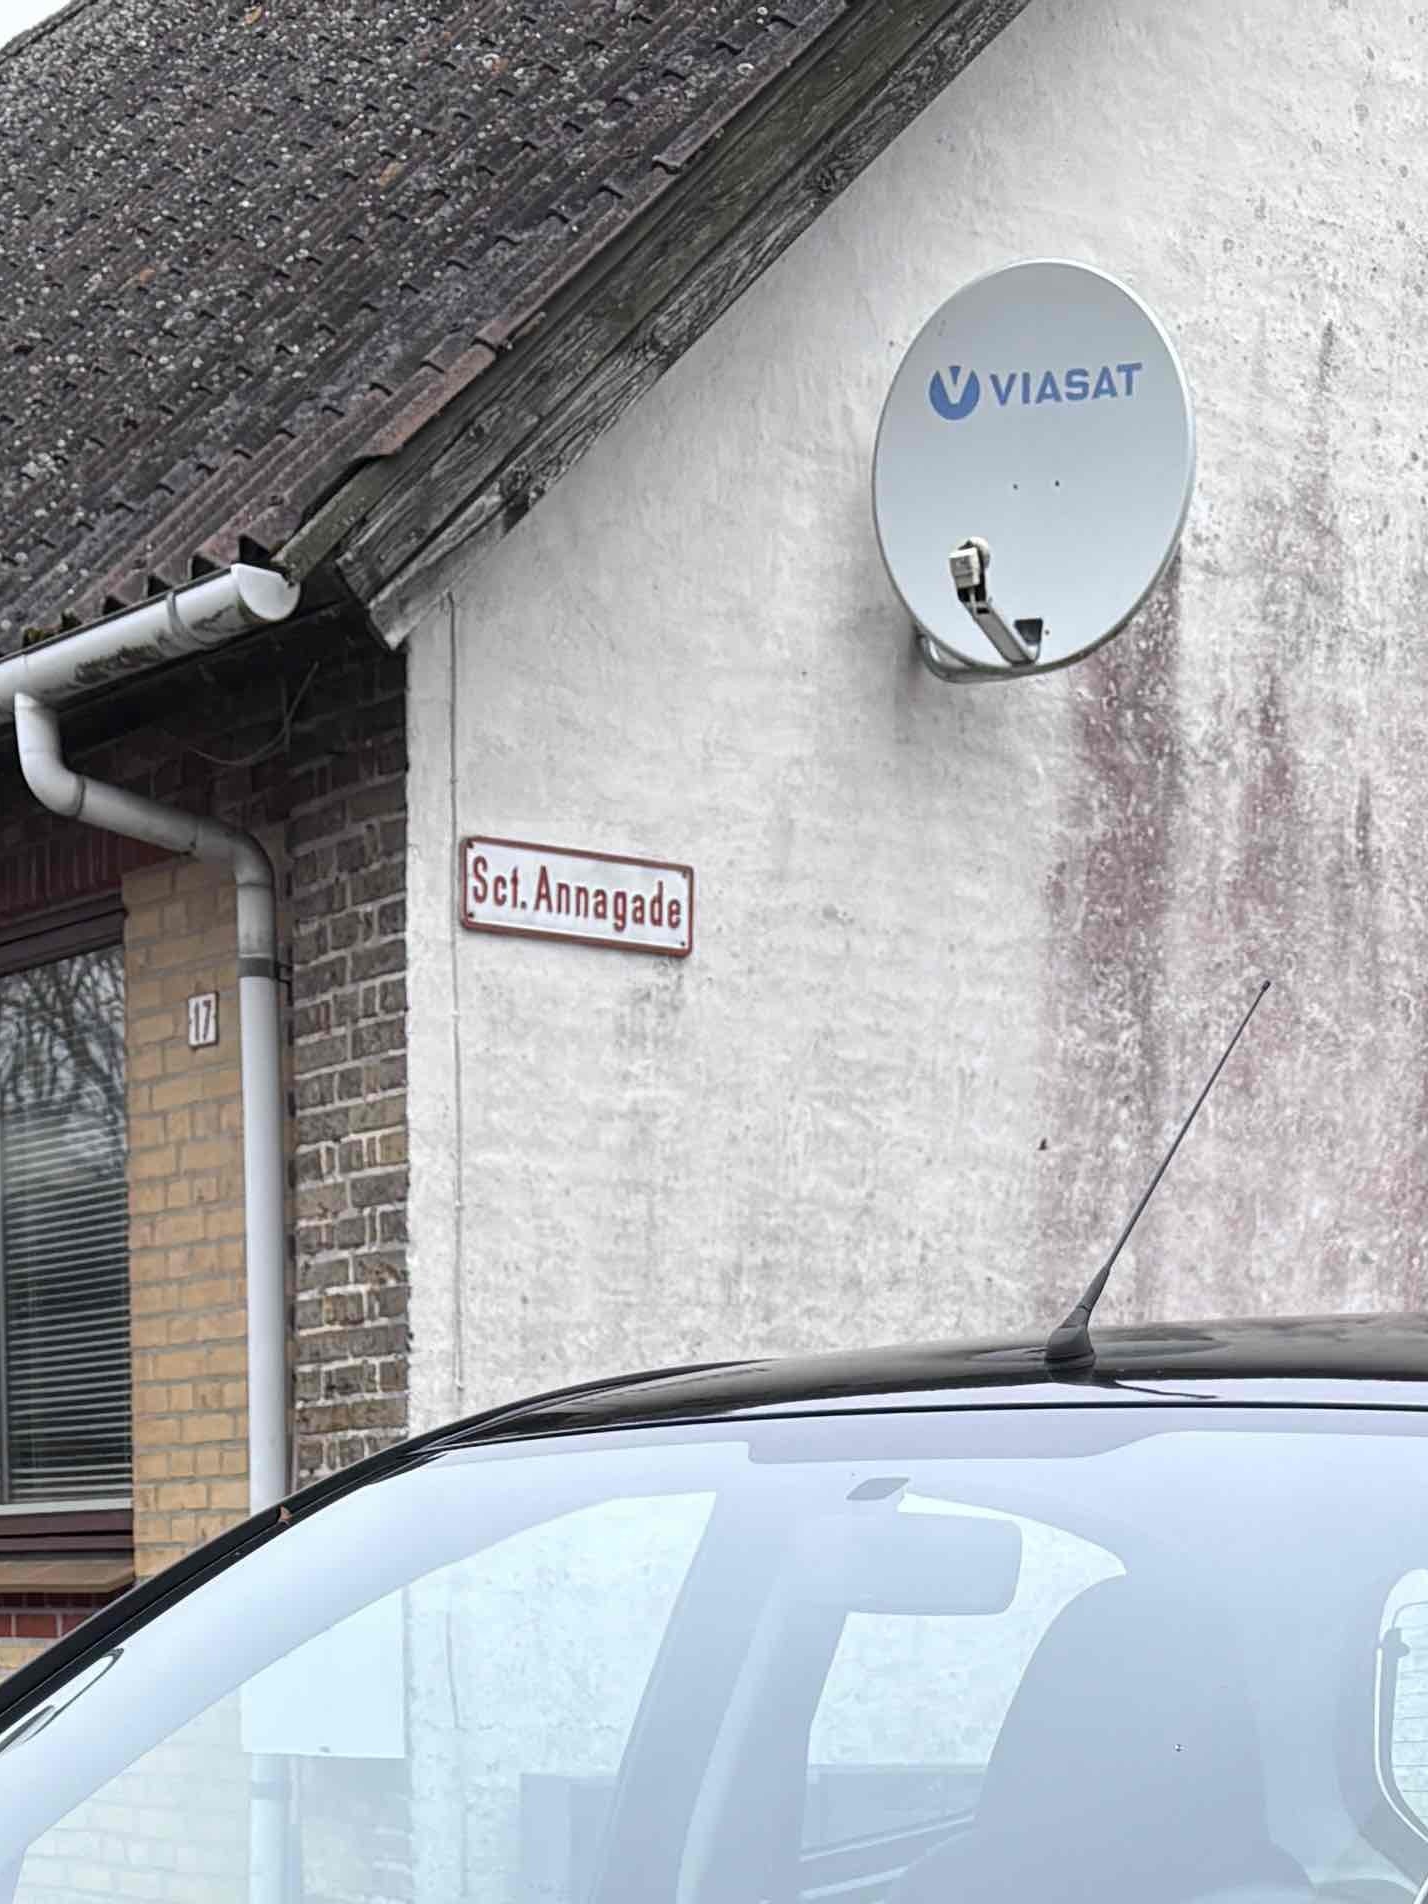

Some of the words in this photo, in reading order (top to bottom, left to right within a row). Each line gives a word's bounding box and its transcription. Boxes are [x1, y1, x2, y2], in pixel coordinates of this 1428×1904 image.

[990, 362, 1143, 407] VIASAT
[473, 856, 527, 910] Sct.
[534, 865, 682, 932] Annagade
[194, 999, 212, 1041] 17
